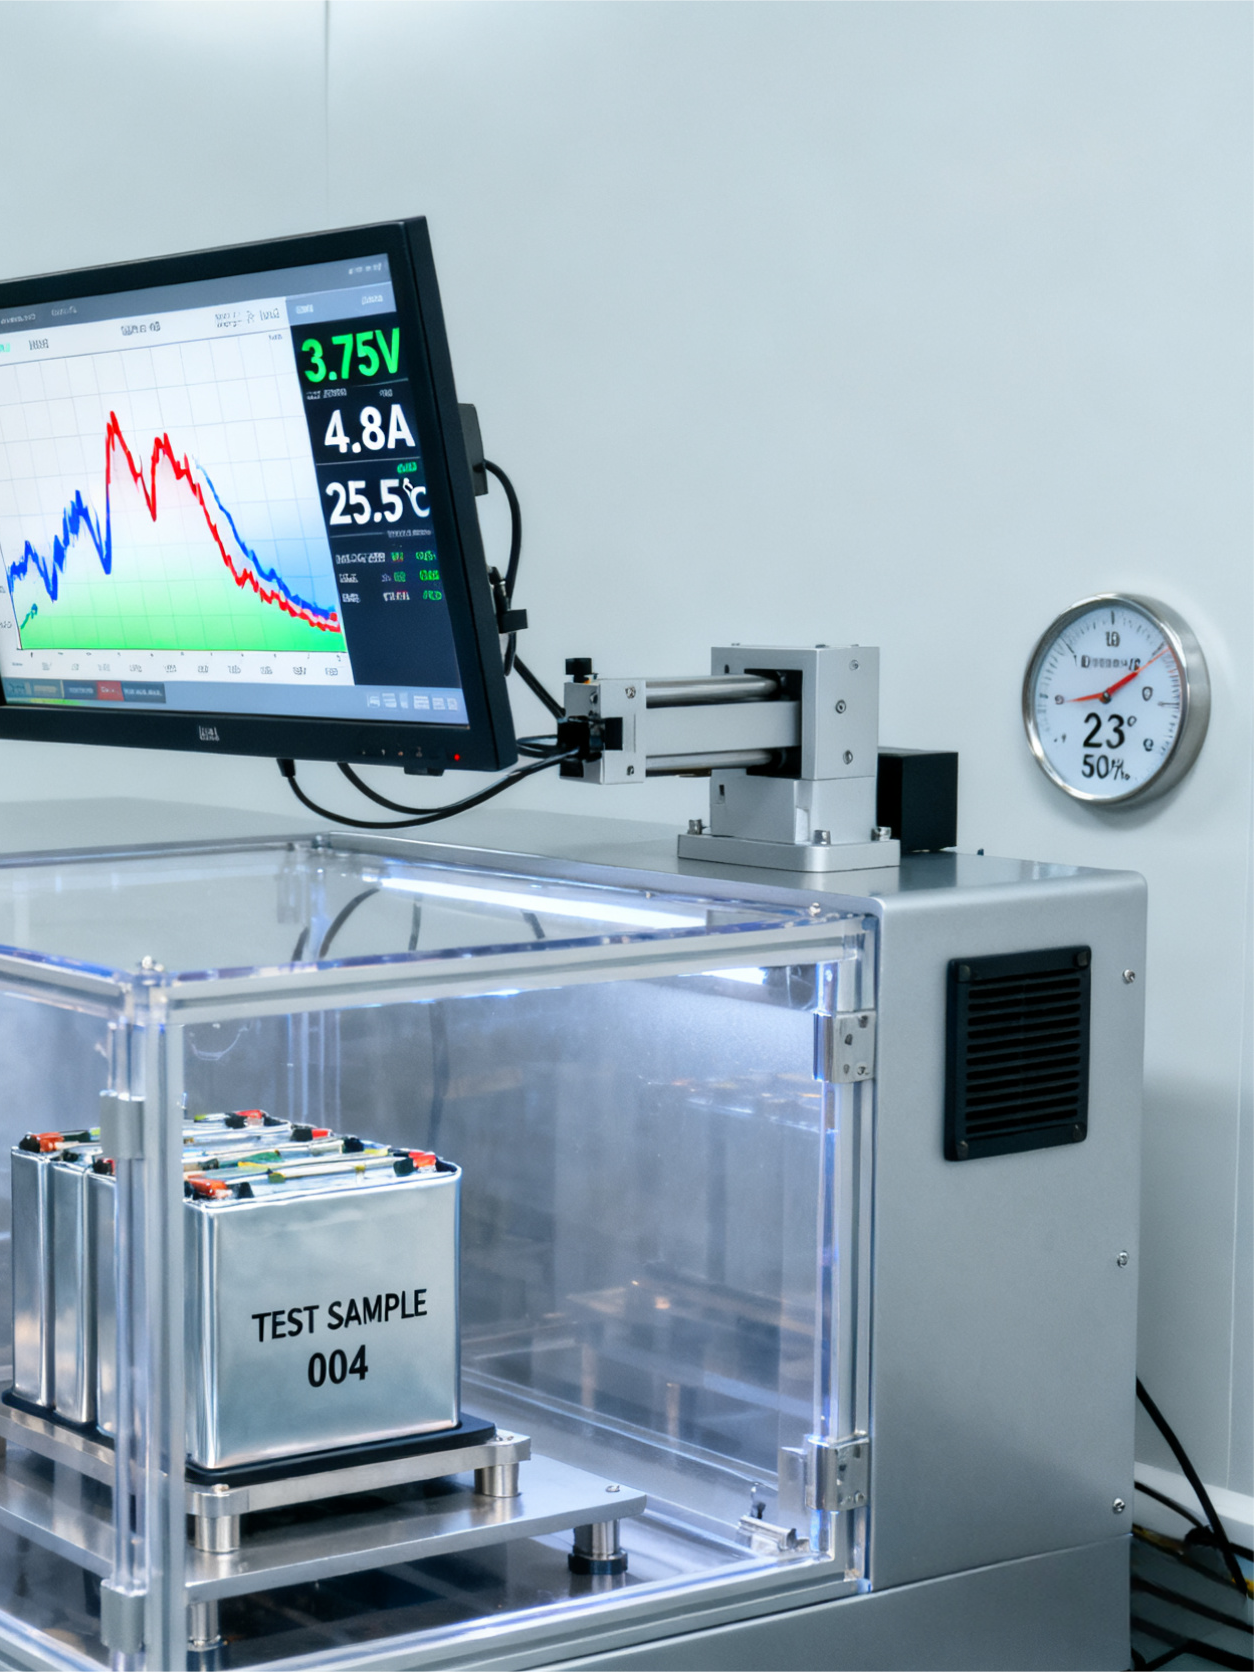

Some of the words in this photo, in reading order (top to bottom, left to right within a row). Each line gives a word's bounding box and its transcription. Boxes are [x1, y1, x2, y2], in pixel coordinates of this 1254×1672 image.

[302, 328, 400, 383] 3.75V
[324, 403, 416, 453] 4.8A
[251, 1305, 320, 1343] TEST
[327, 1288, 428, 1330] SAMPLE
[307, 1344, 369, 1388] 004
